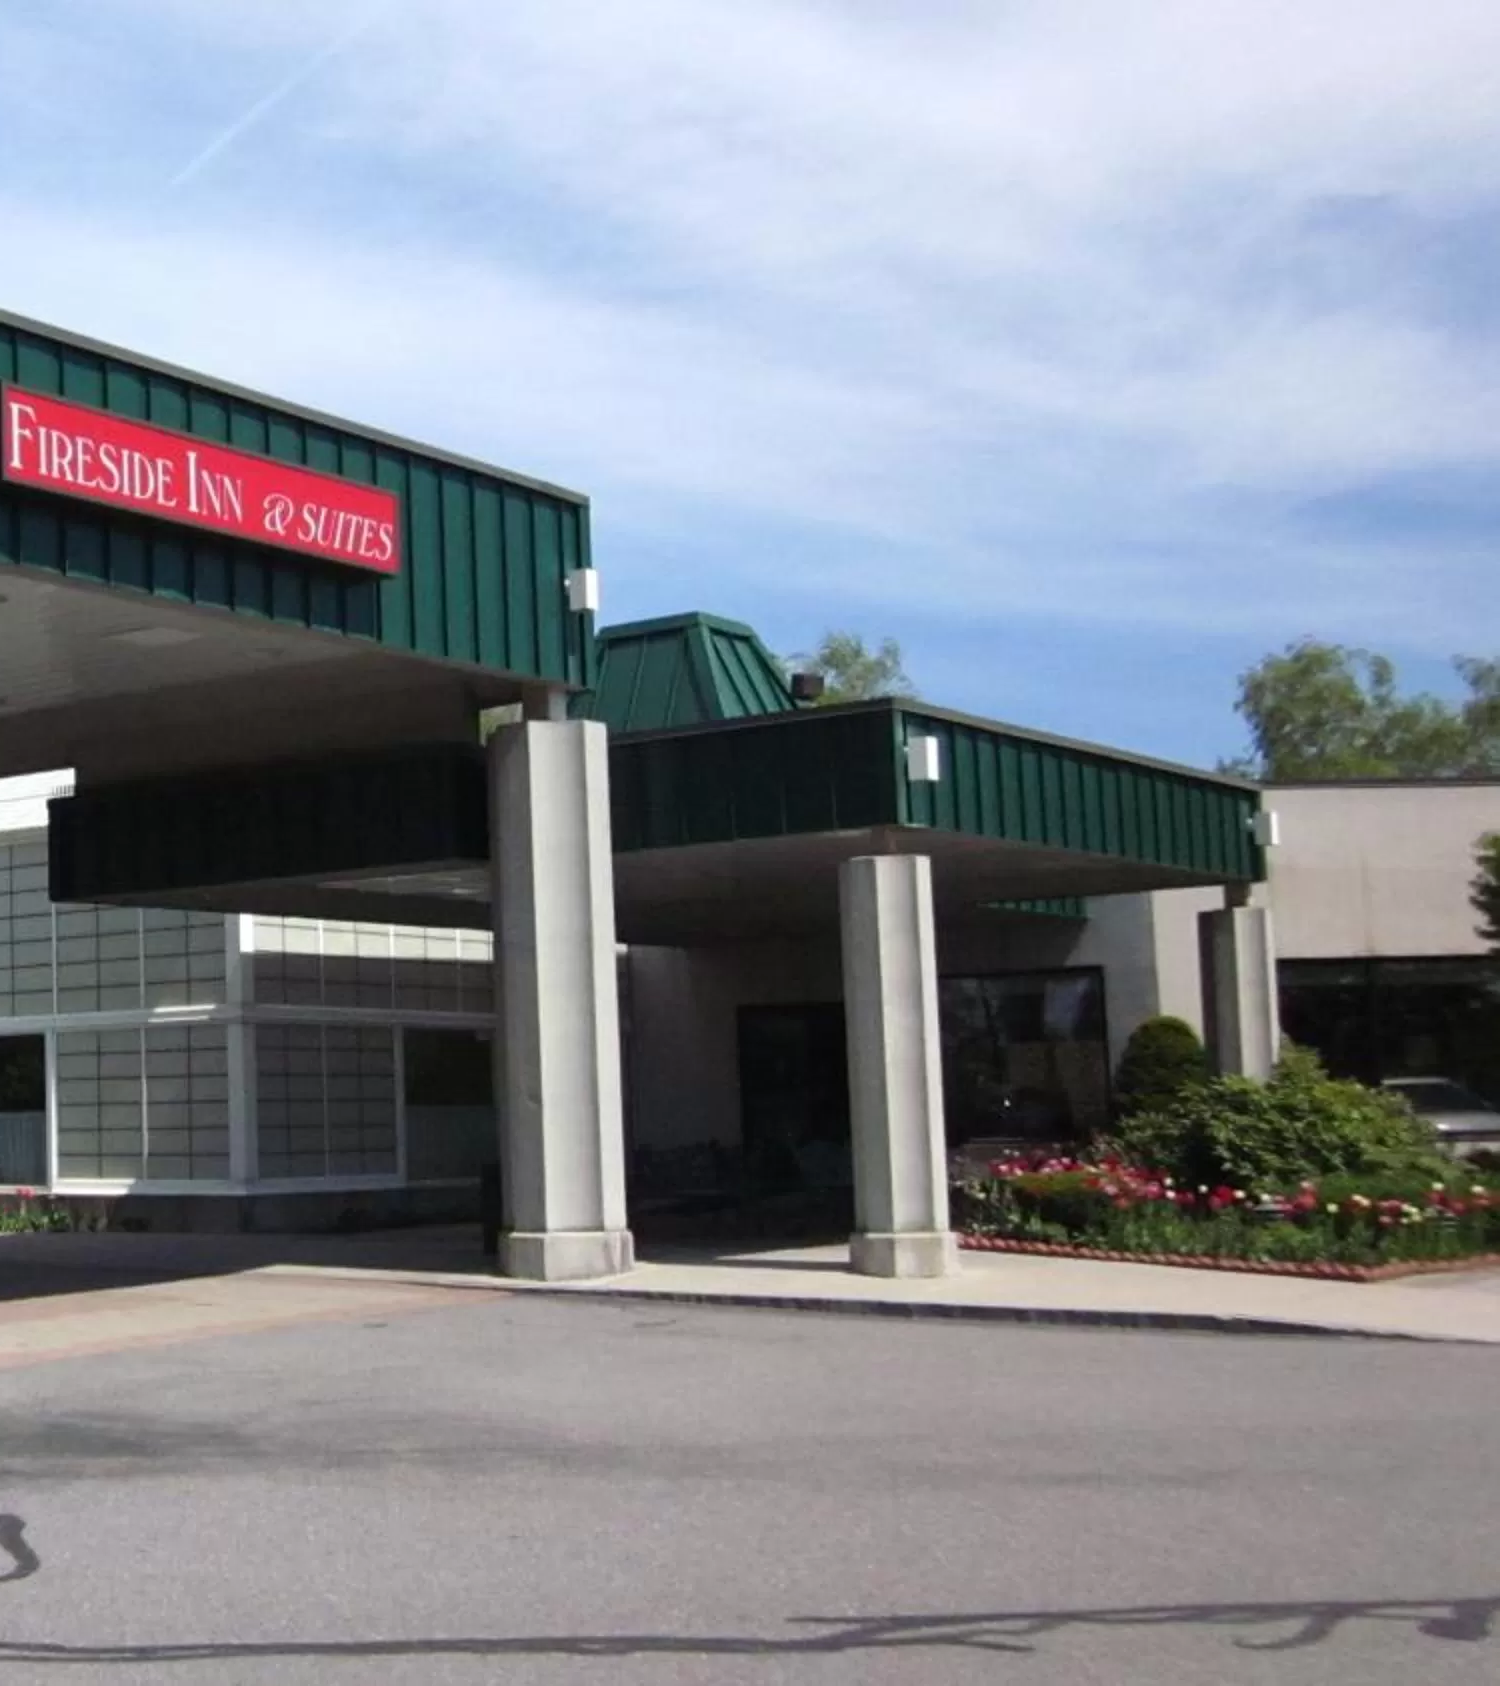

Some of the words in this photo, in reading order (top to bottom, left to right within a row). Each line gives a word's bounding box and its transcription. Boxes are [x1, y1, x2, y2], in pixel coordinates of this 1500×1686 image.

[10, 402, 177, 507] FIRESIDE
[186, 450, 243, 522] INN
[263, 493, 294, 536] &
[297, 502, 394, 561] SUITES
